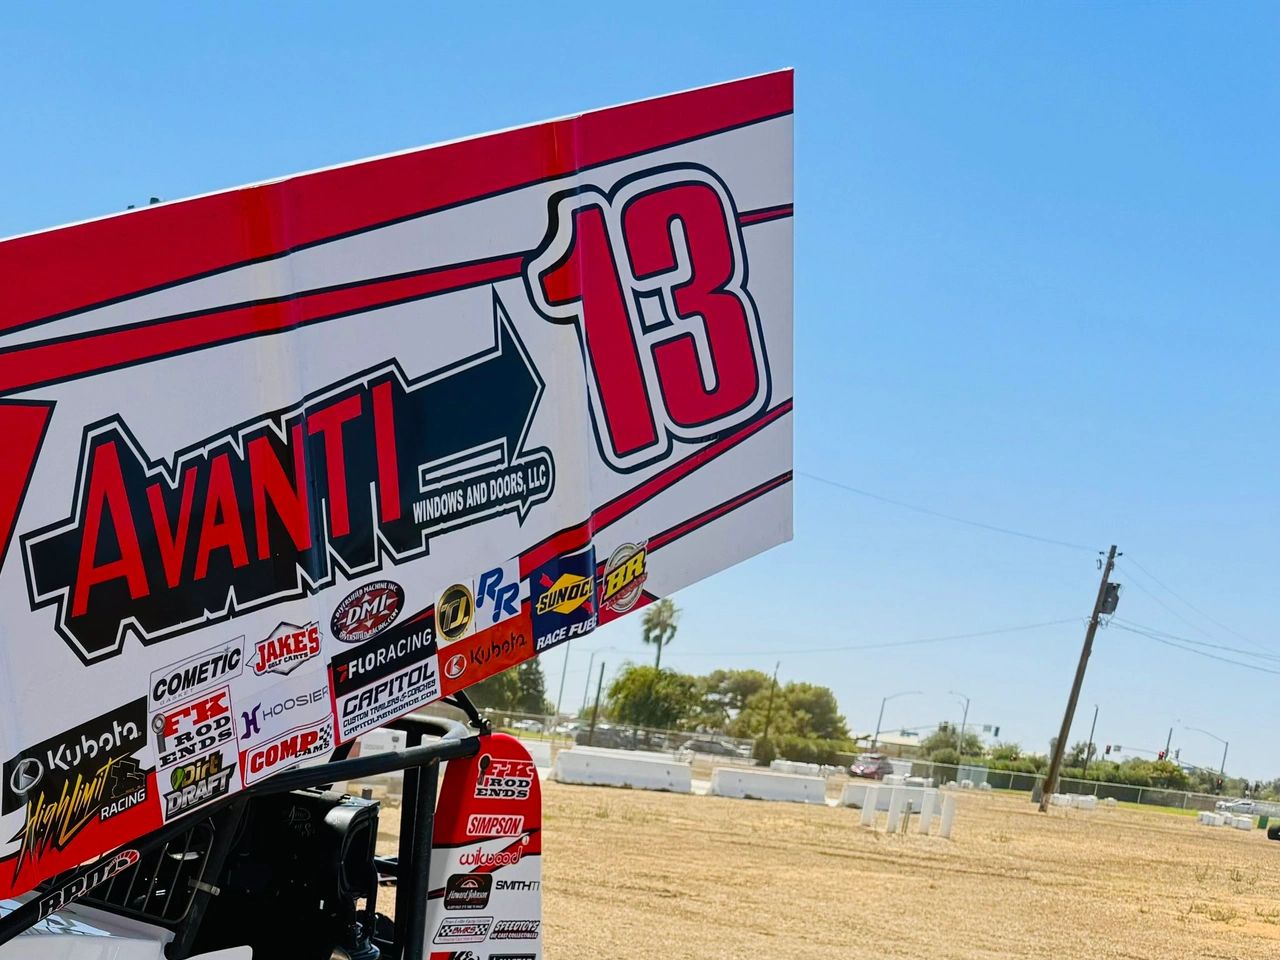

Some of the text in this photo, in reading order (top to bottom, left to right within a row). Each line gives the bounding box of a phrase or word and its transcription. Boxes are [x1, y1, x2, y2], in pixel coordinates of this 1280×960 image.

[535, 175, 764, 464] 13
[412, 465, 547, 524] WINDOWS AND DOORS, LLC
[387, 583, 398, 593] INC
[345, 594, 388, 627] DMI
[255, 627, 321, 673] JAKE'S
[470, 631, 527, 665] Kubota
[536, 626, 568, 650] RACE
[283, 651, 309, 663] CARTS
[152, 648, 242, 702] COMETIC
[341, 662, 436, 718] CAPITOL
[163, 691, 230, 738] FK
[262, 685, 328, 720] HOOSIER
[343, 710, 369, 728] CUSTOM
[369, 696, 400, 716] TRAILERS
[47, 720, 139, 771] Kubota
[159, 727, 233, 768] ENDS
[174, 715, 231, 747] ROD
[250, 730, 319, 774] COMP
[294, 740, 330, 758] CAMS
[183, 750, 224, 783] Dirt
[489, 778, 530, 788] ROD
[100, 789, 146, 820] RACING
[168, 769, 232, 814] DRAFT
[475, 788, 528, 798] ENDS
[468, 816, 522, 835] SIMPSON
[459, 846, 523, 866] wilwood
[494, 921, 539, 931] SPEEDTOYS
